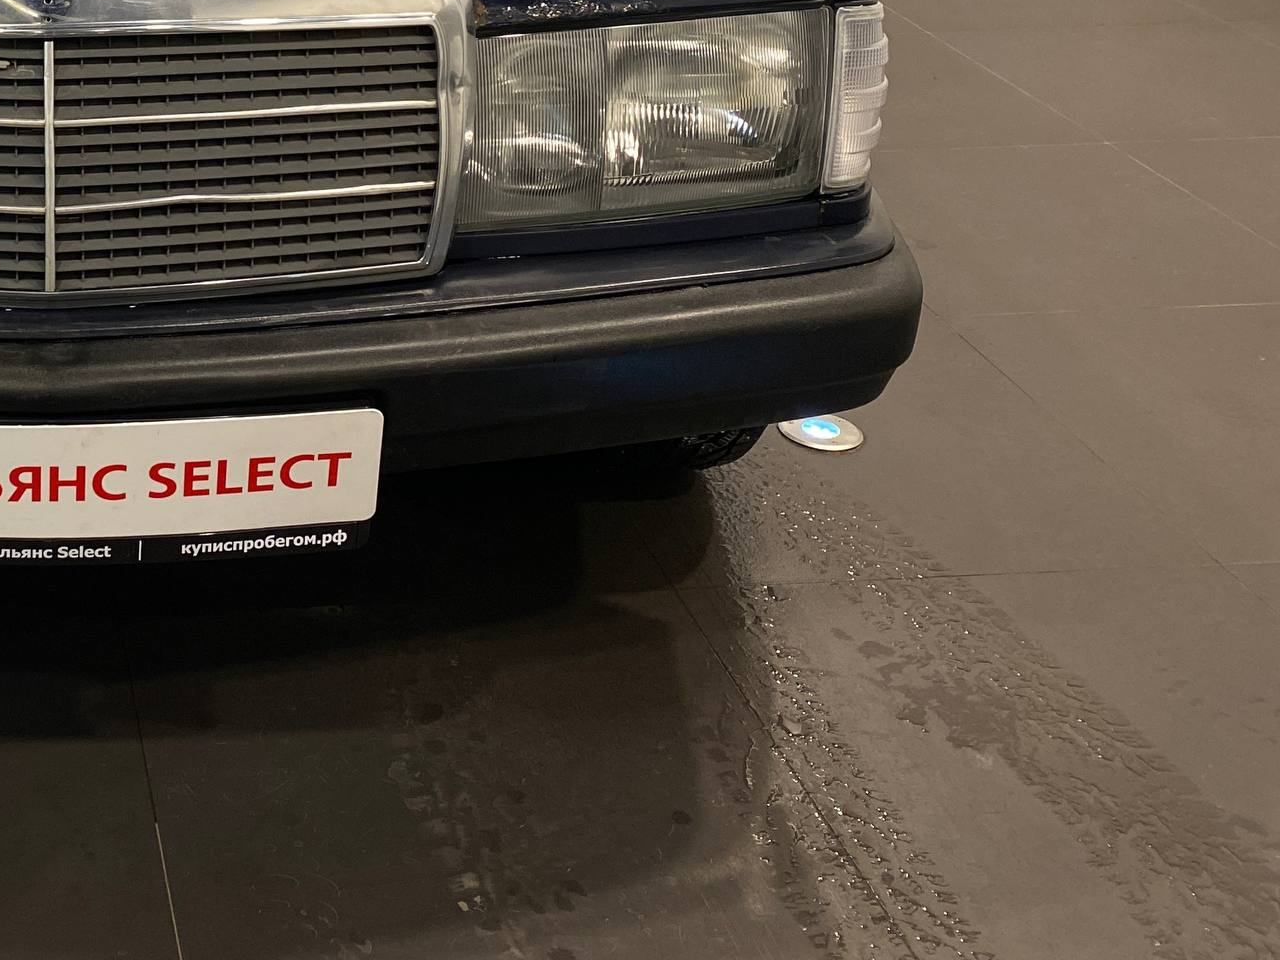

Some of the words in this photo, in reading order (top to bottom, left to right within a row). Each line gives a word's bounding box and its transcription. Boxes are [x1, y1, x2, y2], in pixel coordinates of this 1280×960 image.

[148, 451, 353, 500] SELECT
[56, 545, 112, 559] Select
[180, 528, 348, 557] куписпробегом.рф
